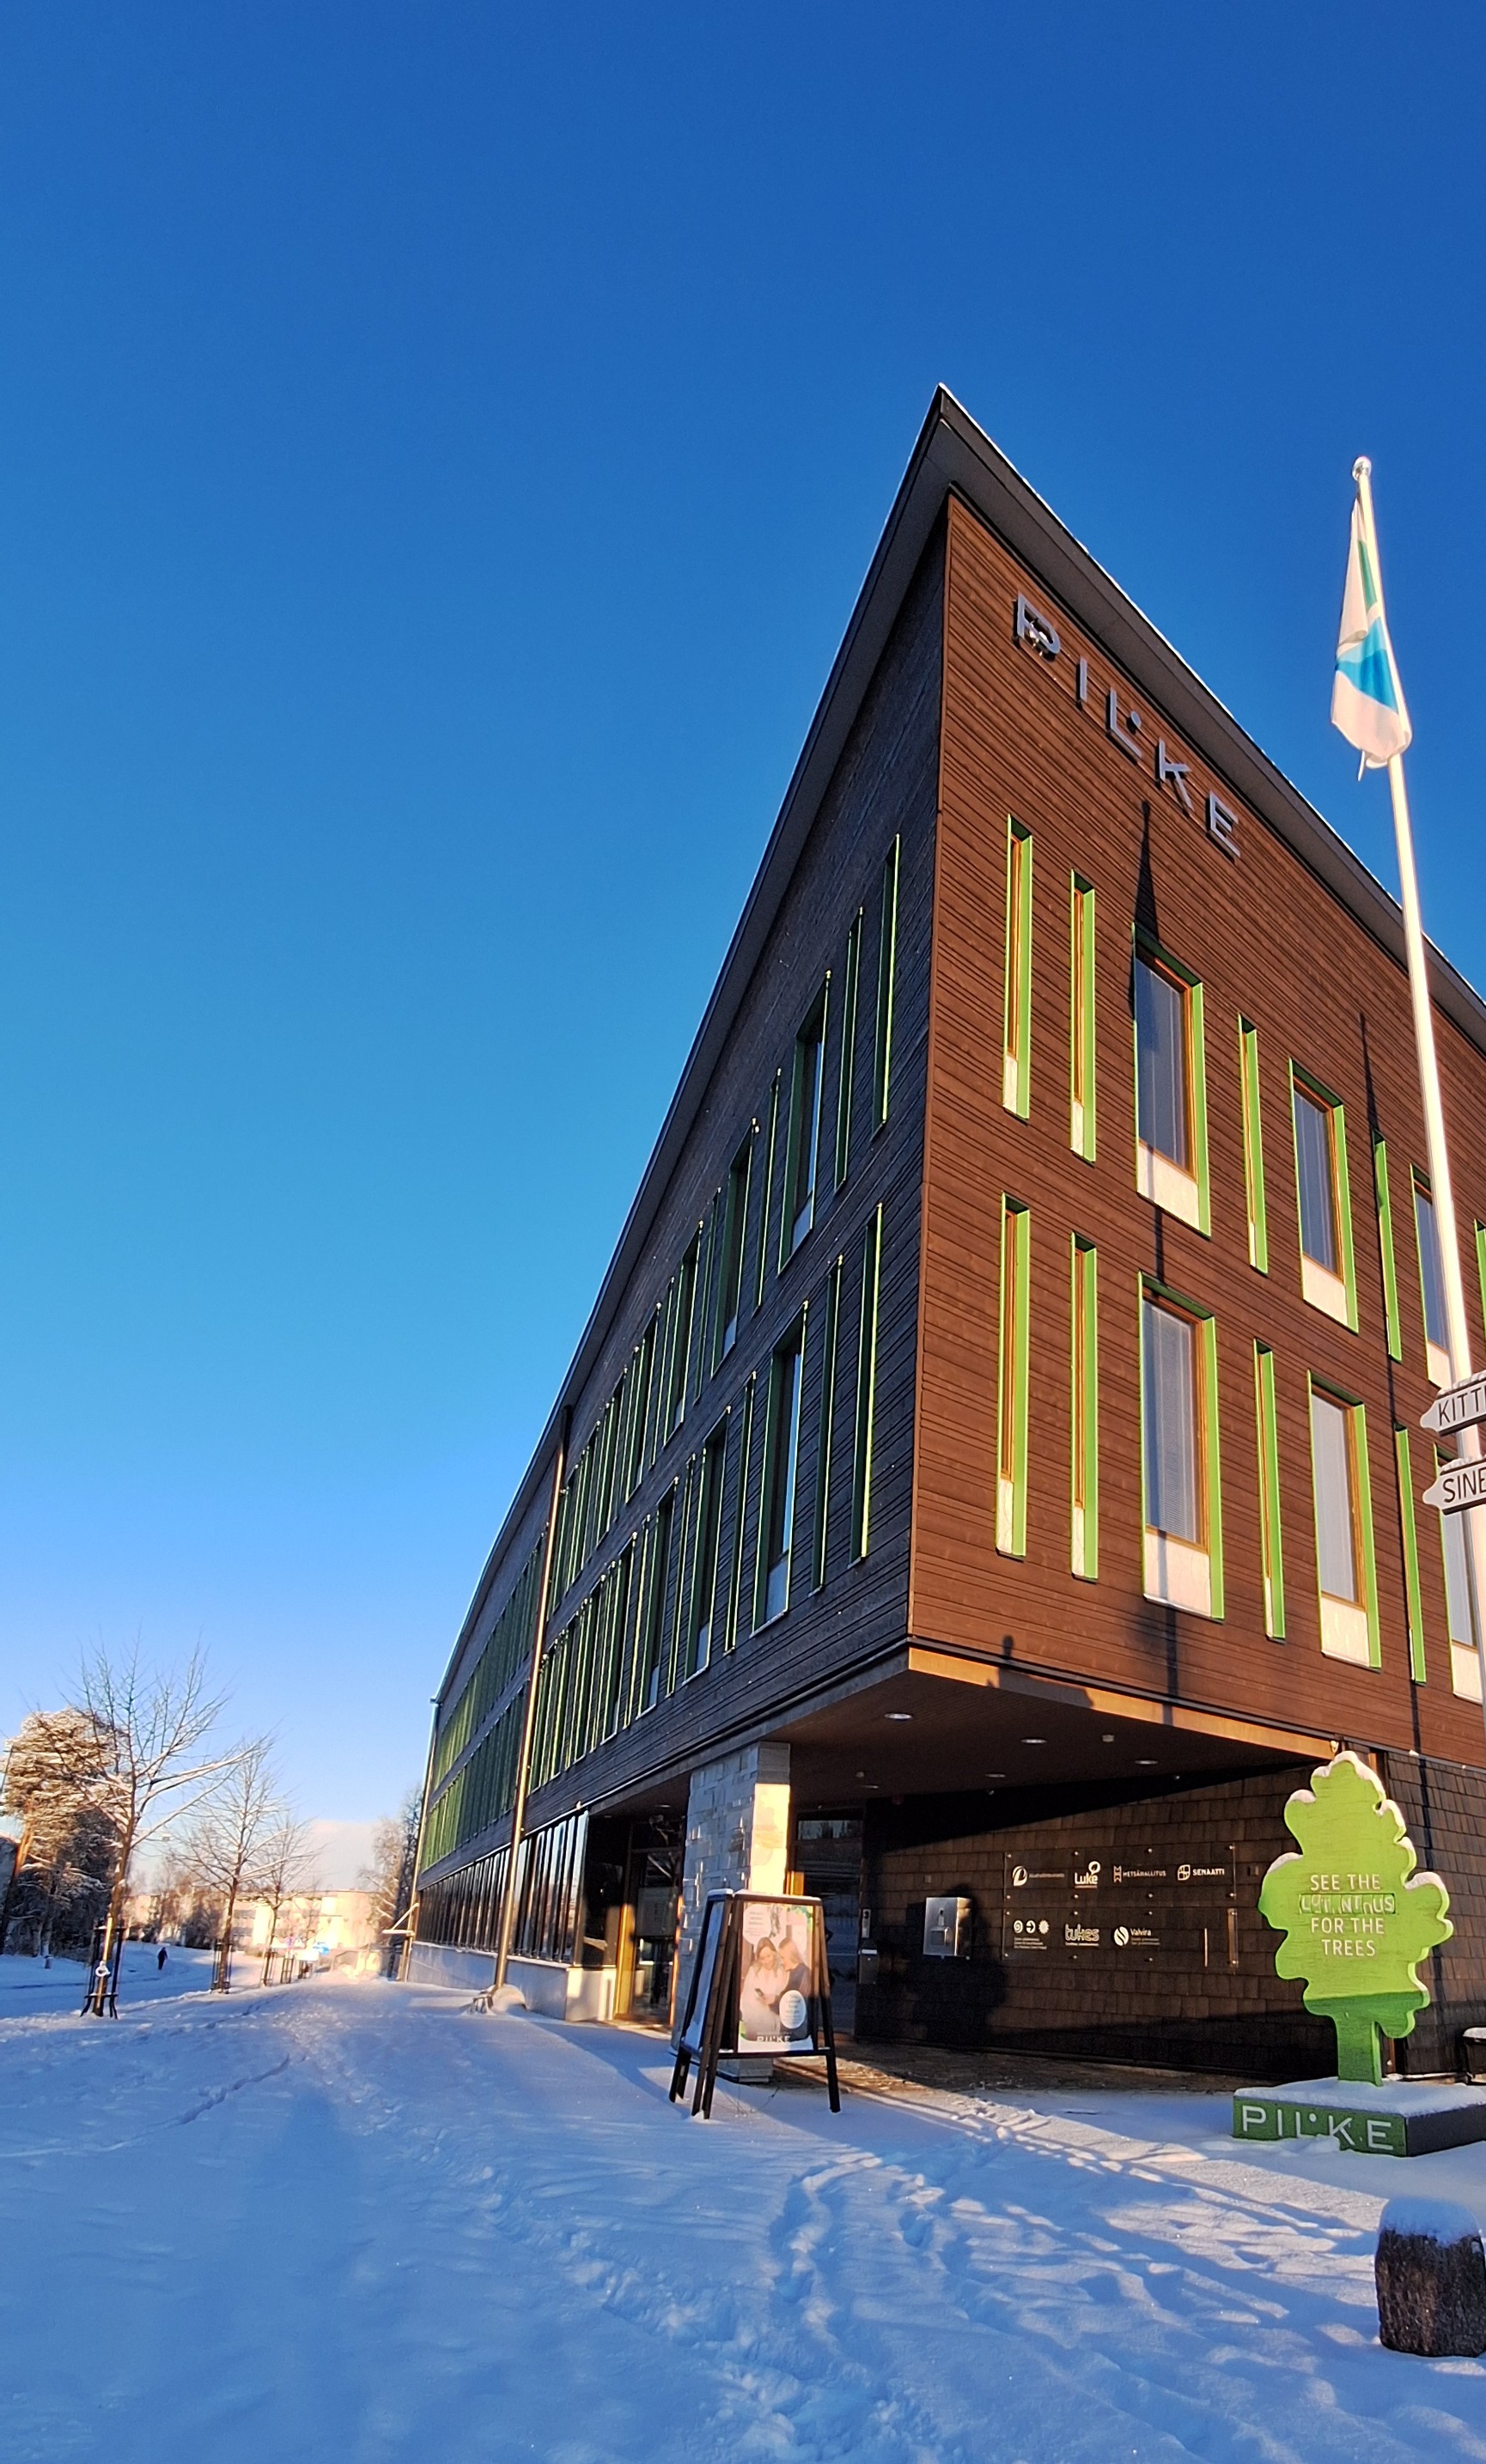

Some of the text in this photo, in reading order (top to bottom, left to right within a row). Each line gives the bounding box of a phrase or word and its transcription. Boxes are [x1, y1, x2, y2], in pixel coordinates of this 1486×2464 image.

[1075, 1865, 1100, 1885] Luke
[1192, 1868, 1225, 1876] SENAATTI
[1310, 1873, 1381, 1891] SEE THE
[1311, 1917, 1385, 1935] FOR THE
[1321, 1939, 1376, 1957] TREES
